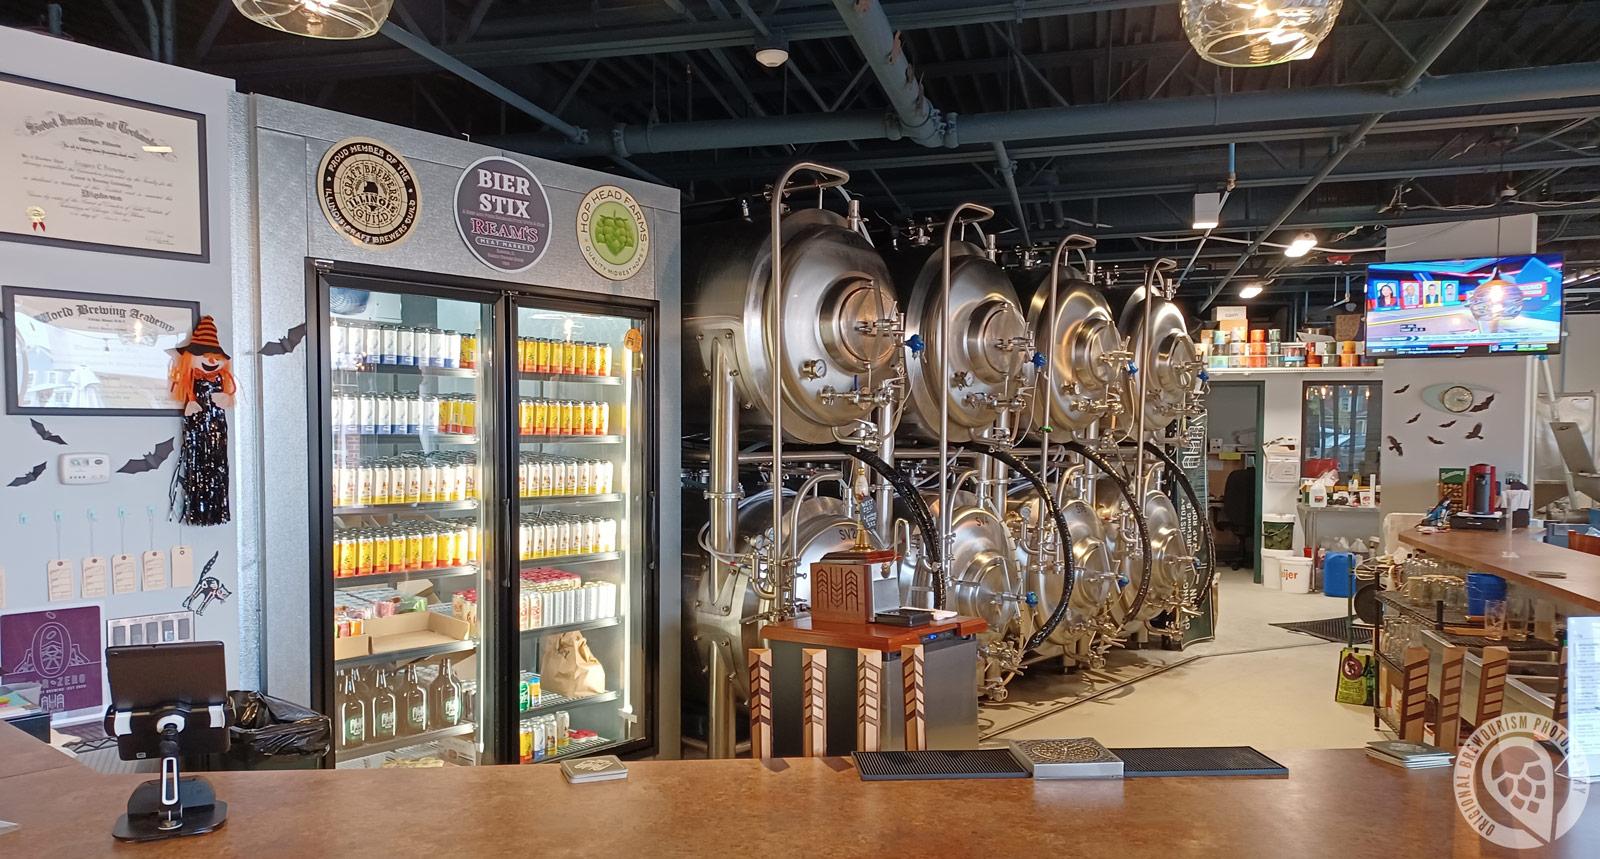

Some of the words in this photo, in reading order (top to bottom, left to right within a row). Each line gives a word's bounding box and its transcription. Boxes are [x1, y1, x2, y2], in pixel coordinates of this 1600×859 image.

[106, 120, 118, 131] of
[328, 149, 349, 172] PROUD
[350, 144, 385, 158] MEMBER
[386, 154, 398, 164] OF
[397, 165, 411, 182] THE
[344, 166, 363, 197] CRAFT
[364, 164, 398, 202] BREWERS
[477, 168, 531, 196] BIER
[325, 188, 343, 225] ILLINOIS
[372, 224, 408, 244] BREWERS
[405, 199, 416, 224] GUILD
[346, 194, 397, 215] ILLINOIS
[355, 208, 389, 224] GUILD
[479, 192, 531, 219] STIX
[580, 202, 591, 233] HOP
[591, 189, 622, 204] HEAD
[623, 196, 648, 243] FARMS
[471, 217, 539, 243] REAM'S
[480, 238, 499, 246] MEAT
[502, 242, 531, 251] MARKET
[585, 245, 606, 271] QUALITY
[632, 253, 644, 269] HOPS
[34, 307, 74, 324] World
[75, 304, 126, 319] Brewing
[129, 308, 176, 333] Academy
[839, 527, 857, 541] SV2
[57, 673, 86, 687] ZERO
